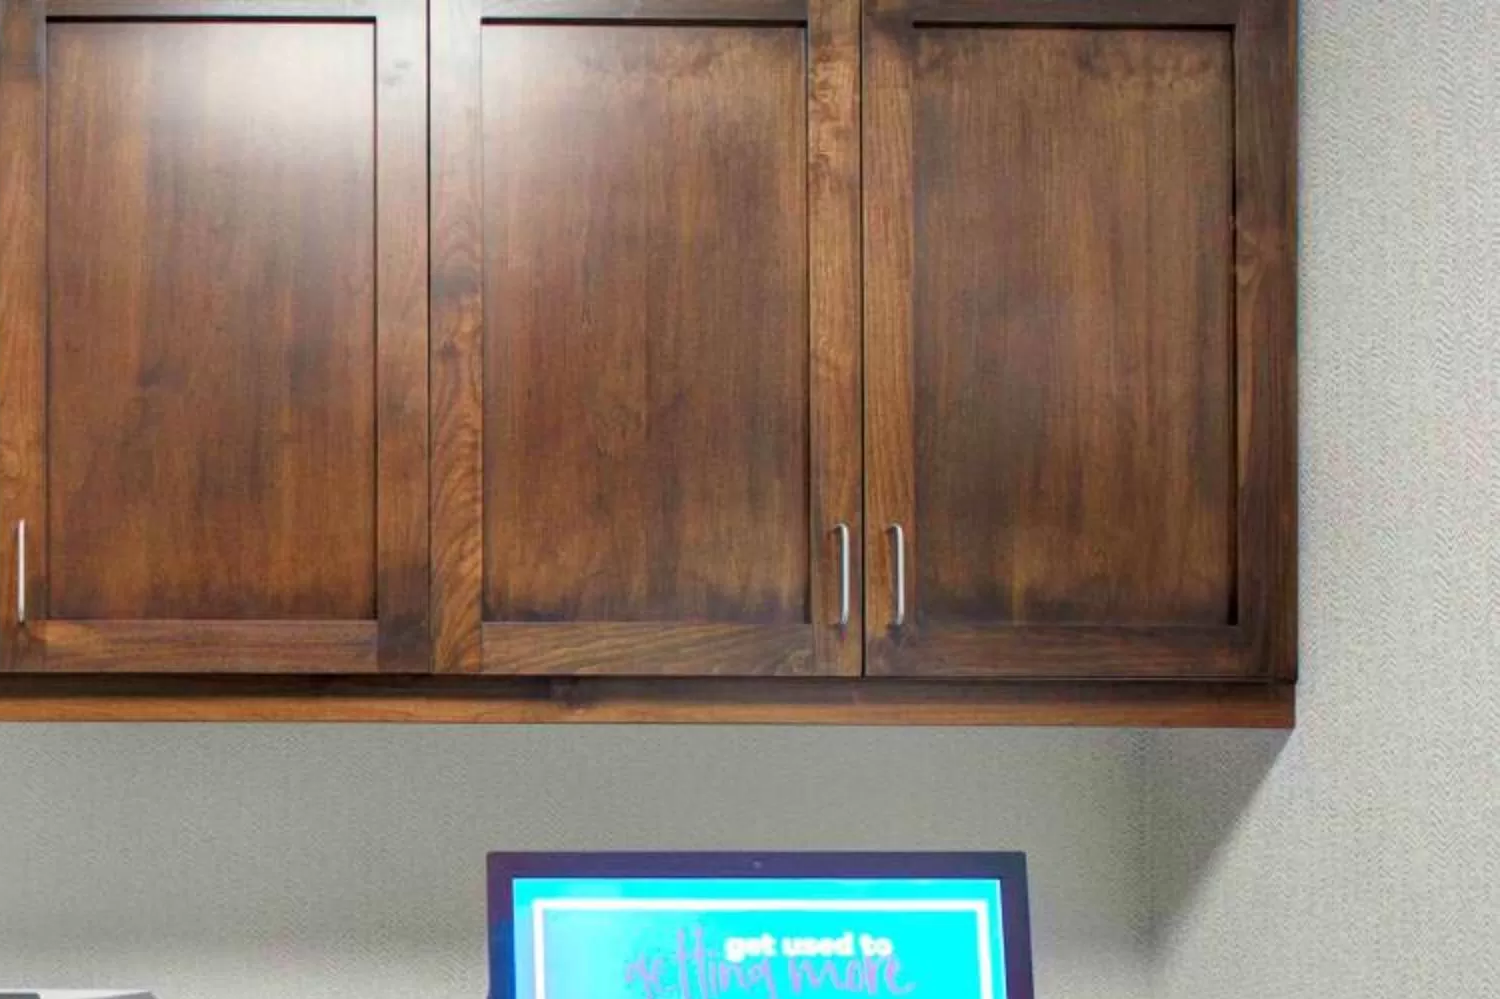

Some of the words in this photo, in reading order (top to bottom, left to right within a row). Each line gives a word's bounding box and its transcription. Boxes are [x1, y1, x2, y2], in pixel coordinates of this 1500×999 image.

[724, 932, 777, 963] get
[781, 930, 855, 958] used
[859, 931, 894, 958] to
[788, 953, 917, 996] more
